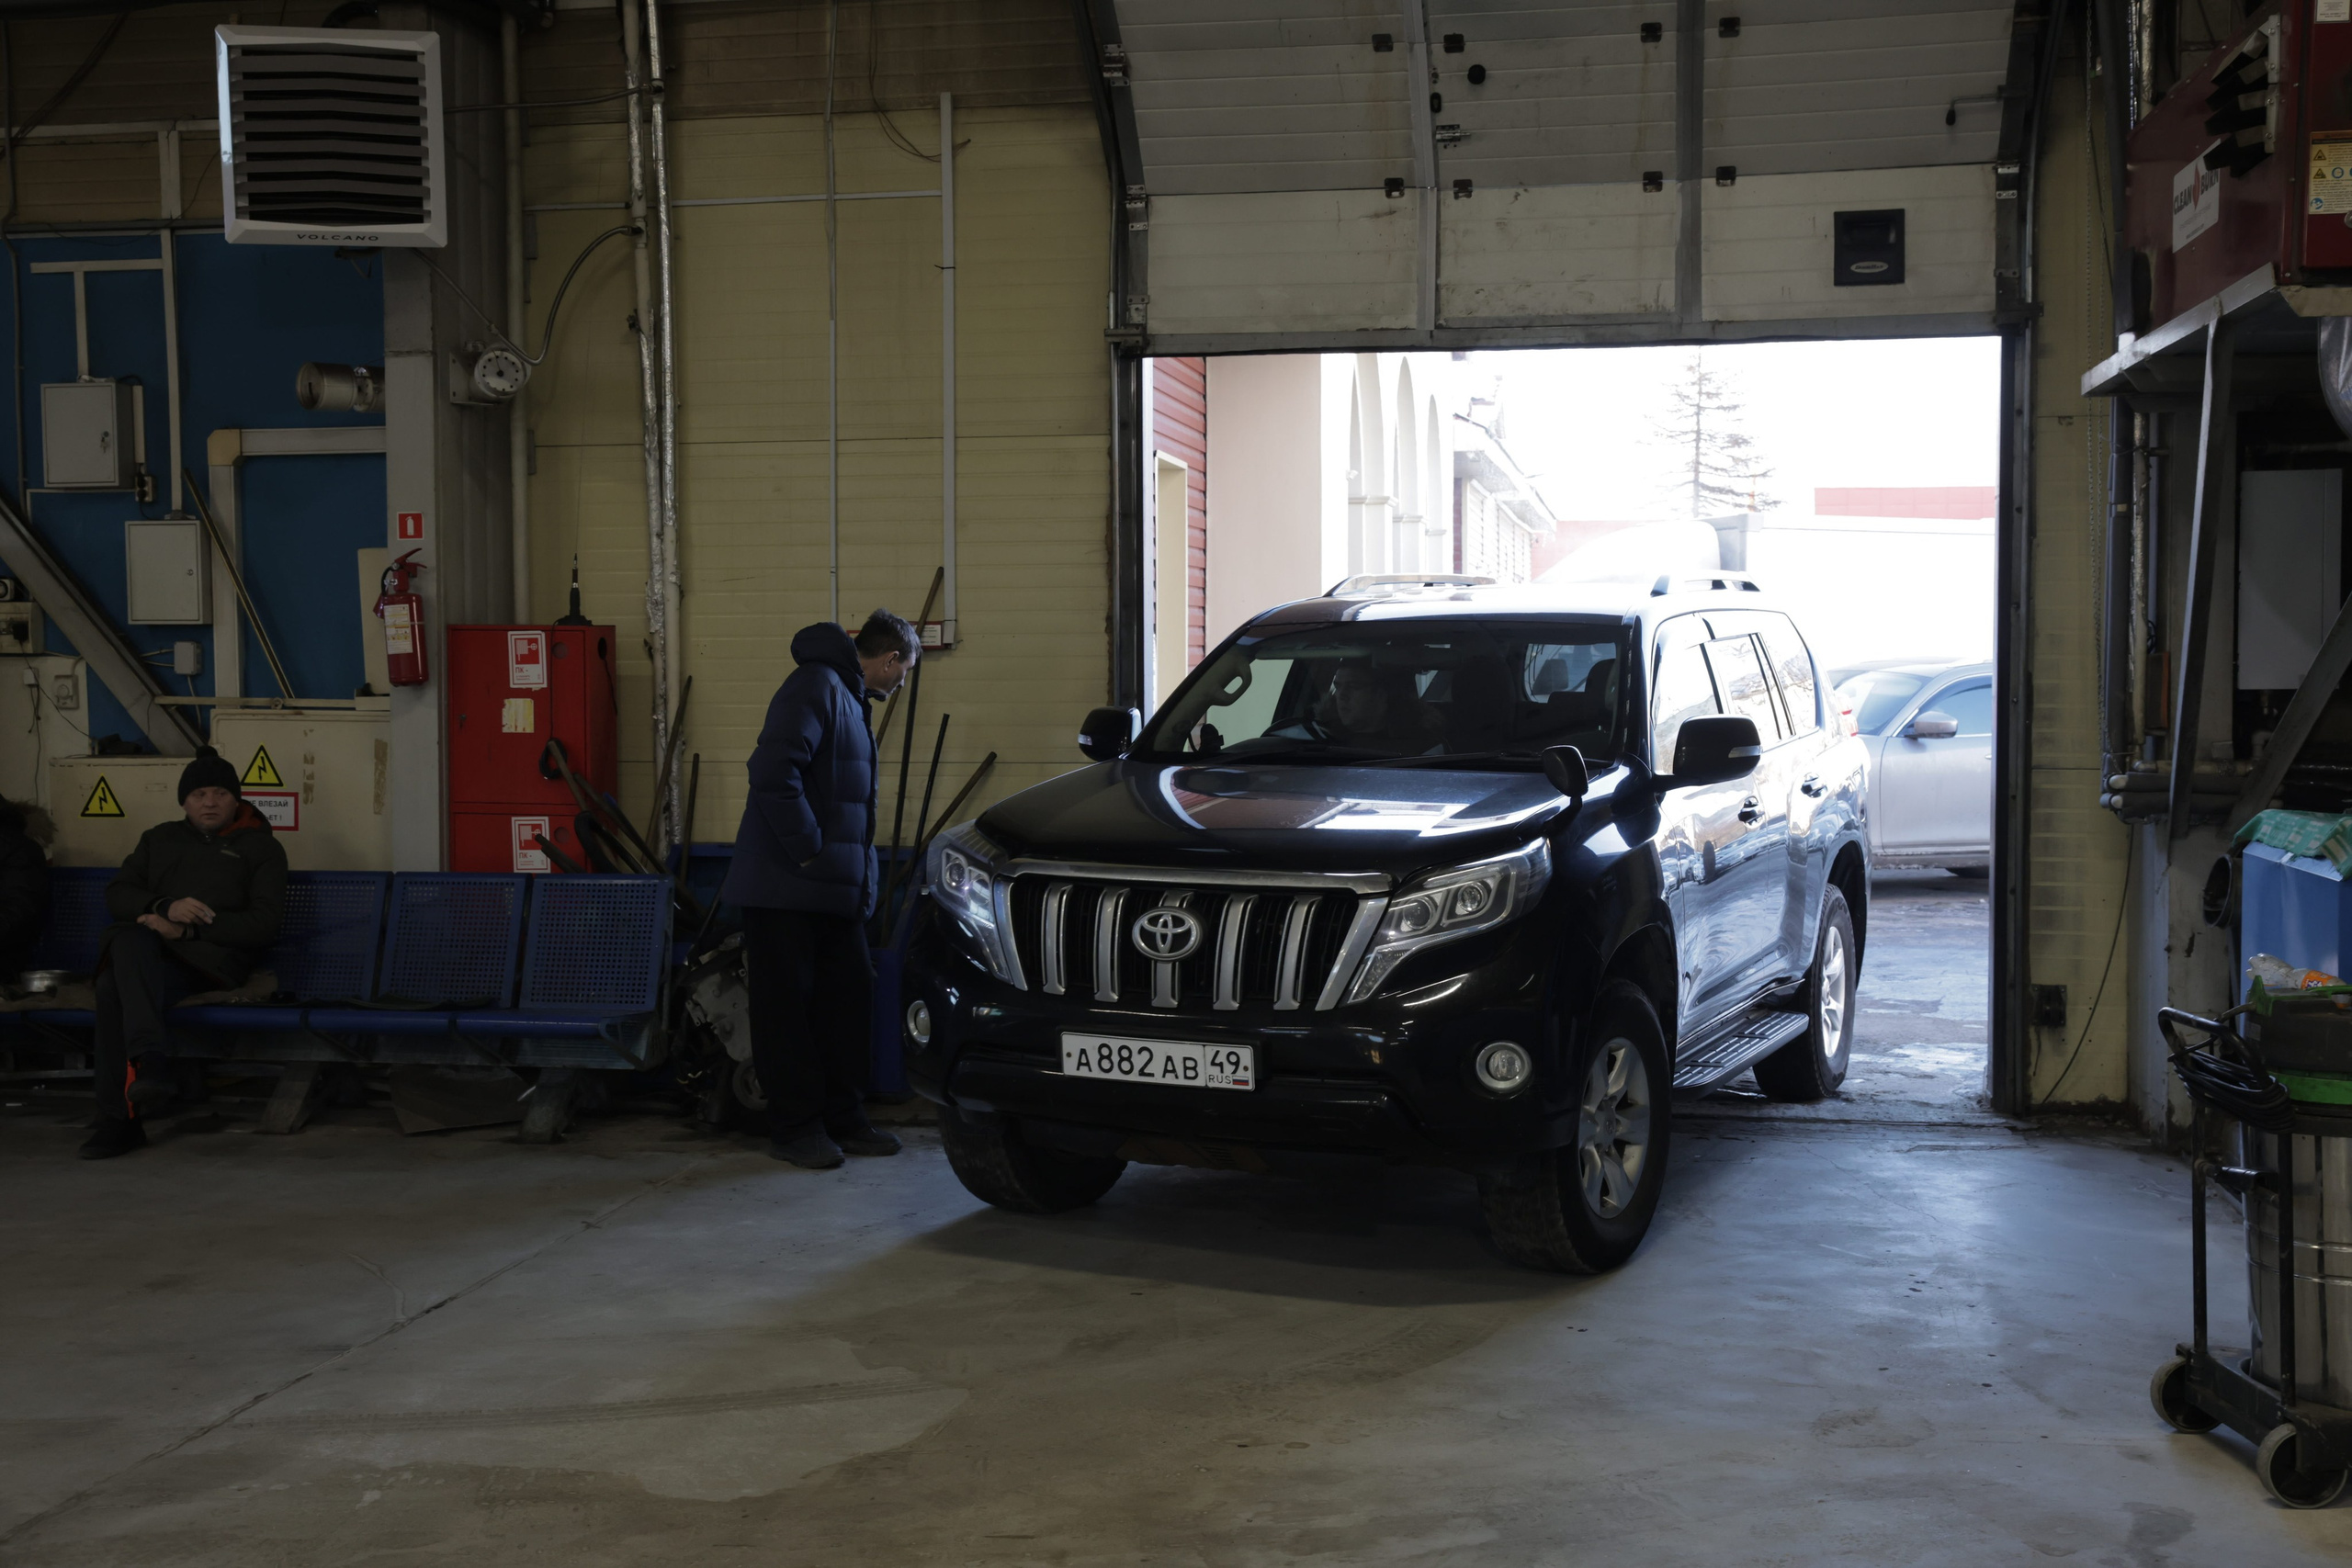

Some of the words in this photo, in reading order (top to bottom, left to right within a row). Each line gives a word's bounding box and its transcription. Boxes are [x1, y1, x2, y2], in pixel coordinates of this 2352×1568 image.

[2174, 185, 2192, 215] CLEAN
[2200, 168, 2219, 196] BURN
[1210, 1050, 1240, 1075] 49
[1209, 1075, 1232, 1084] RUS
